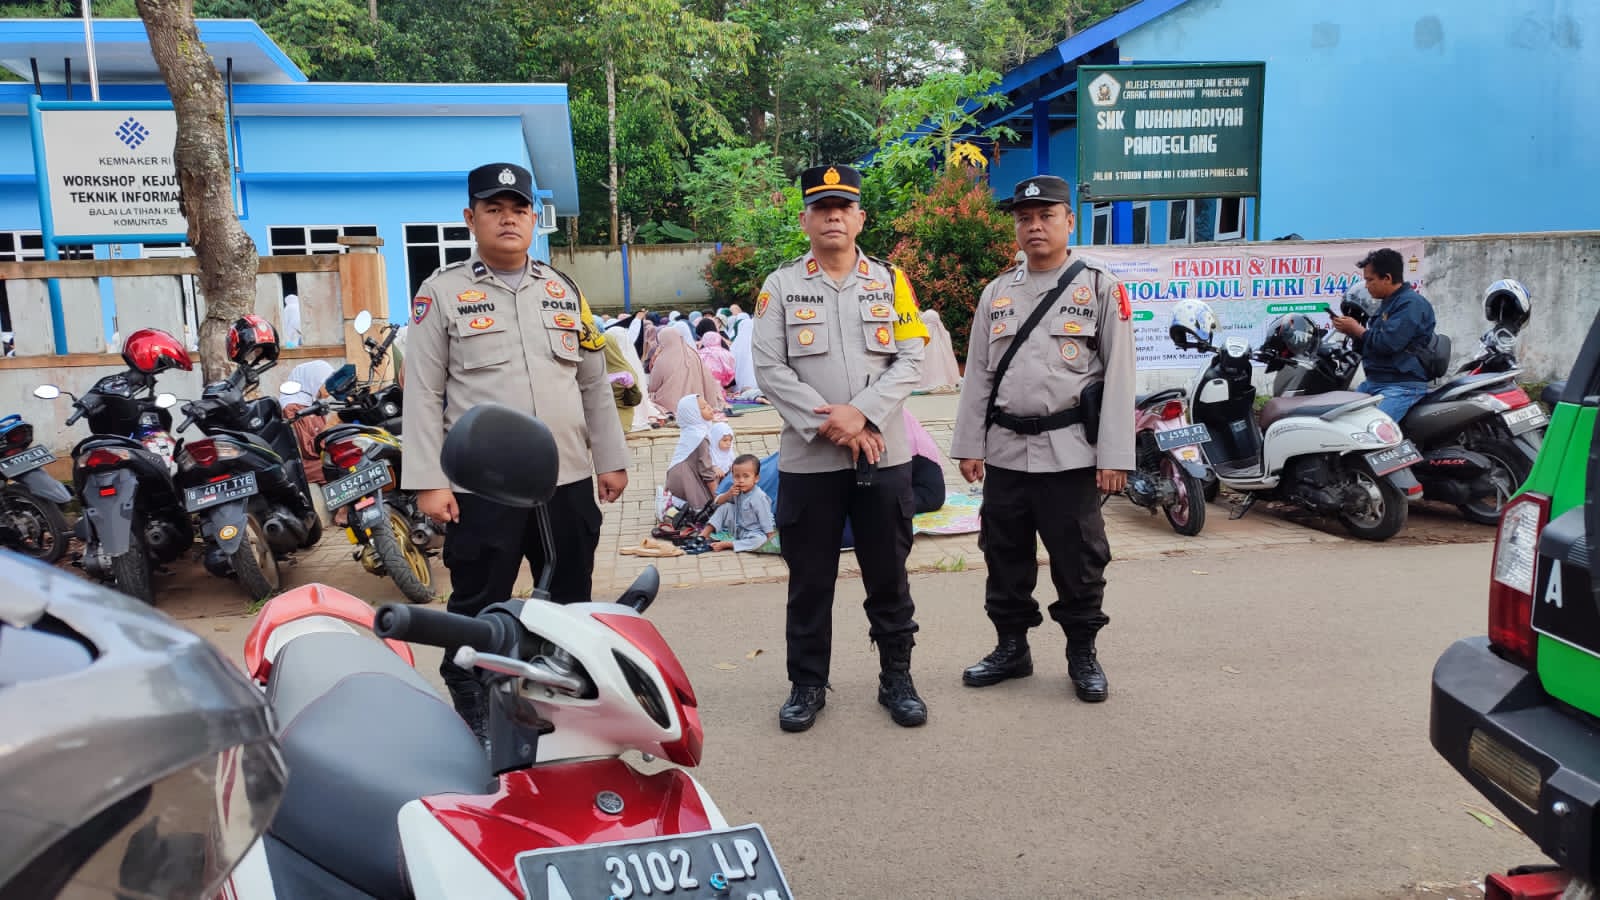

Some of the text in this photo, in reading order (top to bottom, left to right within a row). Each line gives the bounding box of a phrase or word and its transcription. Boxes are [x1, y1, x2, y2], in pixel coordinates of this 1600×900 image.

[1201, 88, 1244, 98] PANDEGLANG
[1096, 107, 1244, 130] SMK MUHAMMADIYAH
[1124, 134, 1218, 155] PANDEGLANG
[98, 157, 171, 166] KEMNAKER RI
[63, 175, 135, 187] WORKSHOP
[70, 191, 180, 203] TEKNIK INFORMA
[88, 208, 117, 216] BALAI
[119, 207, 161, 215] LATIHAN
[113, 218, 168, 226] KOMUNITAS
[1174, 257, 1321, 277] HADIRI & IKUTI
[1125, 281, 1189, 300] HOLAT
[1197, 279, 1244, 298] IDUL
[1252, 278, 1305, 297] FITRI
[786, 294, 824, 304] OSMAN
[858, 292, 893, 303] POLRI
[457, 303, 495, 315] WAHYU
[542, 300, 577, 311] POLRI
[1059, 305, 1094, 318] POLRI
[232, 476, 254, 488] TYE
[329, 487, 337, 497] A
[1544, 558, 1563, 609] A
[546, 838, 758, 900] A 3102 LP
